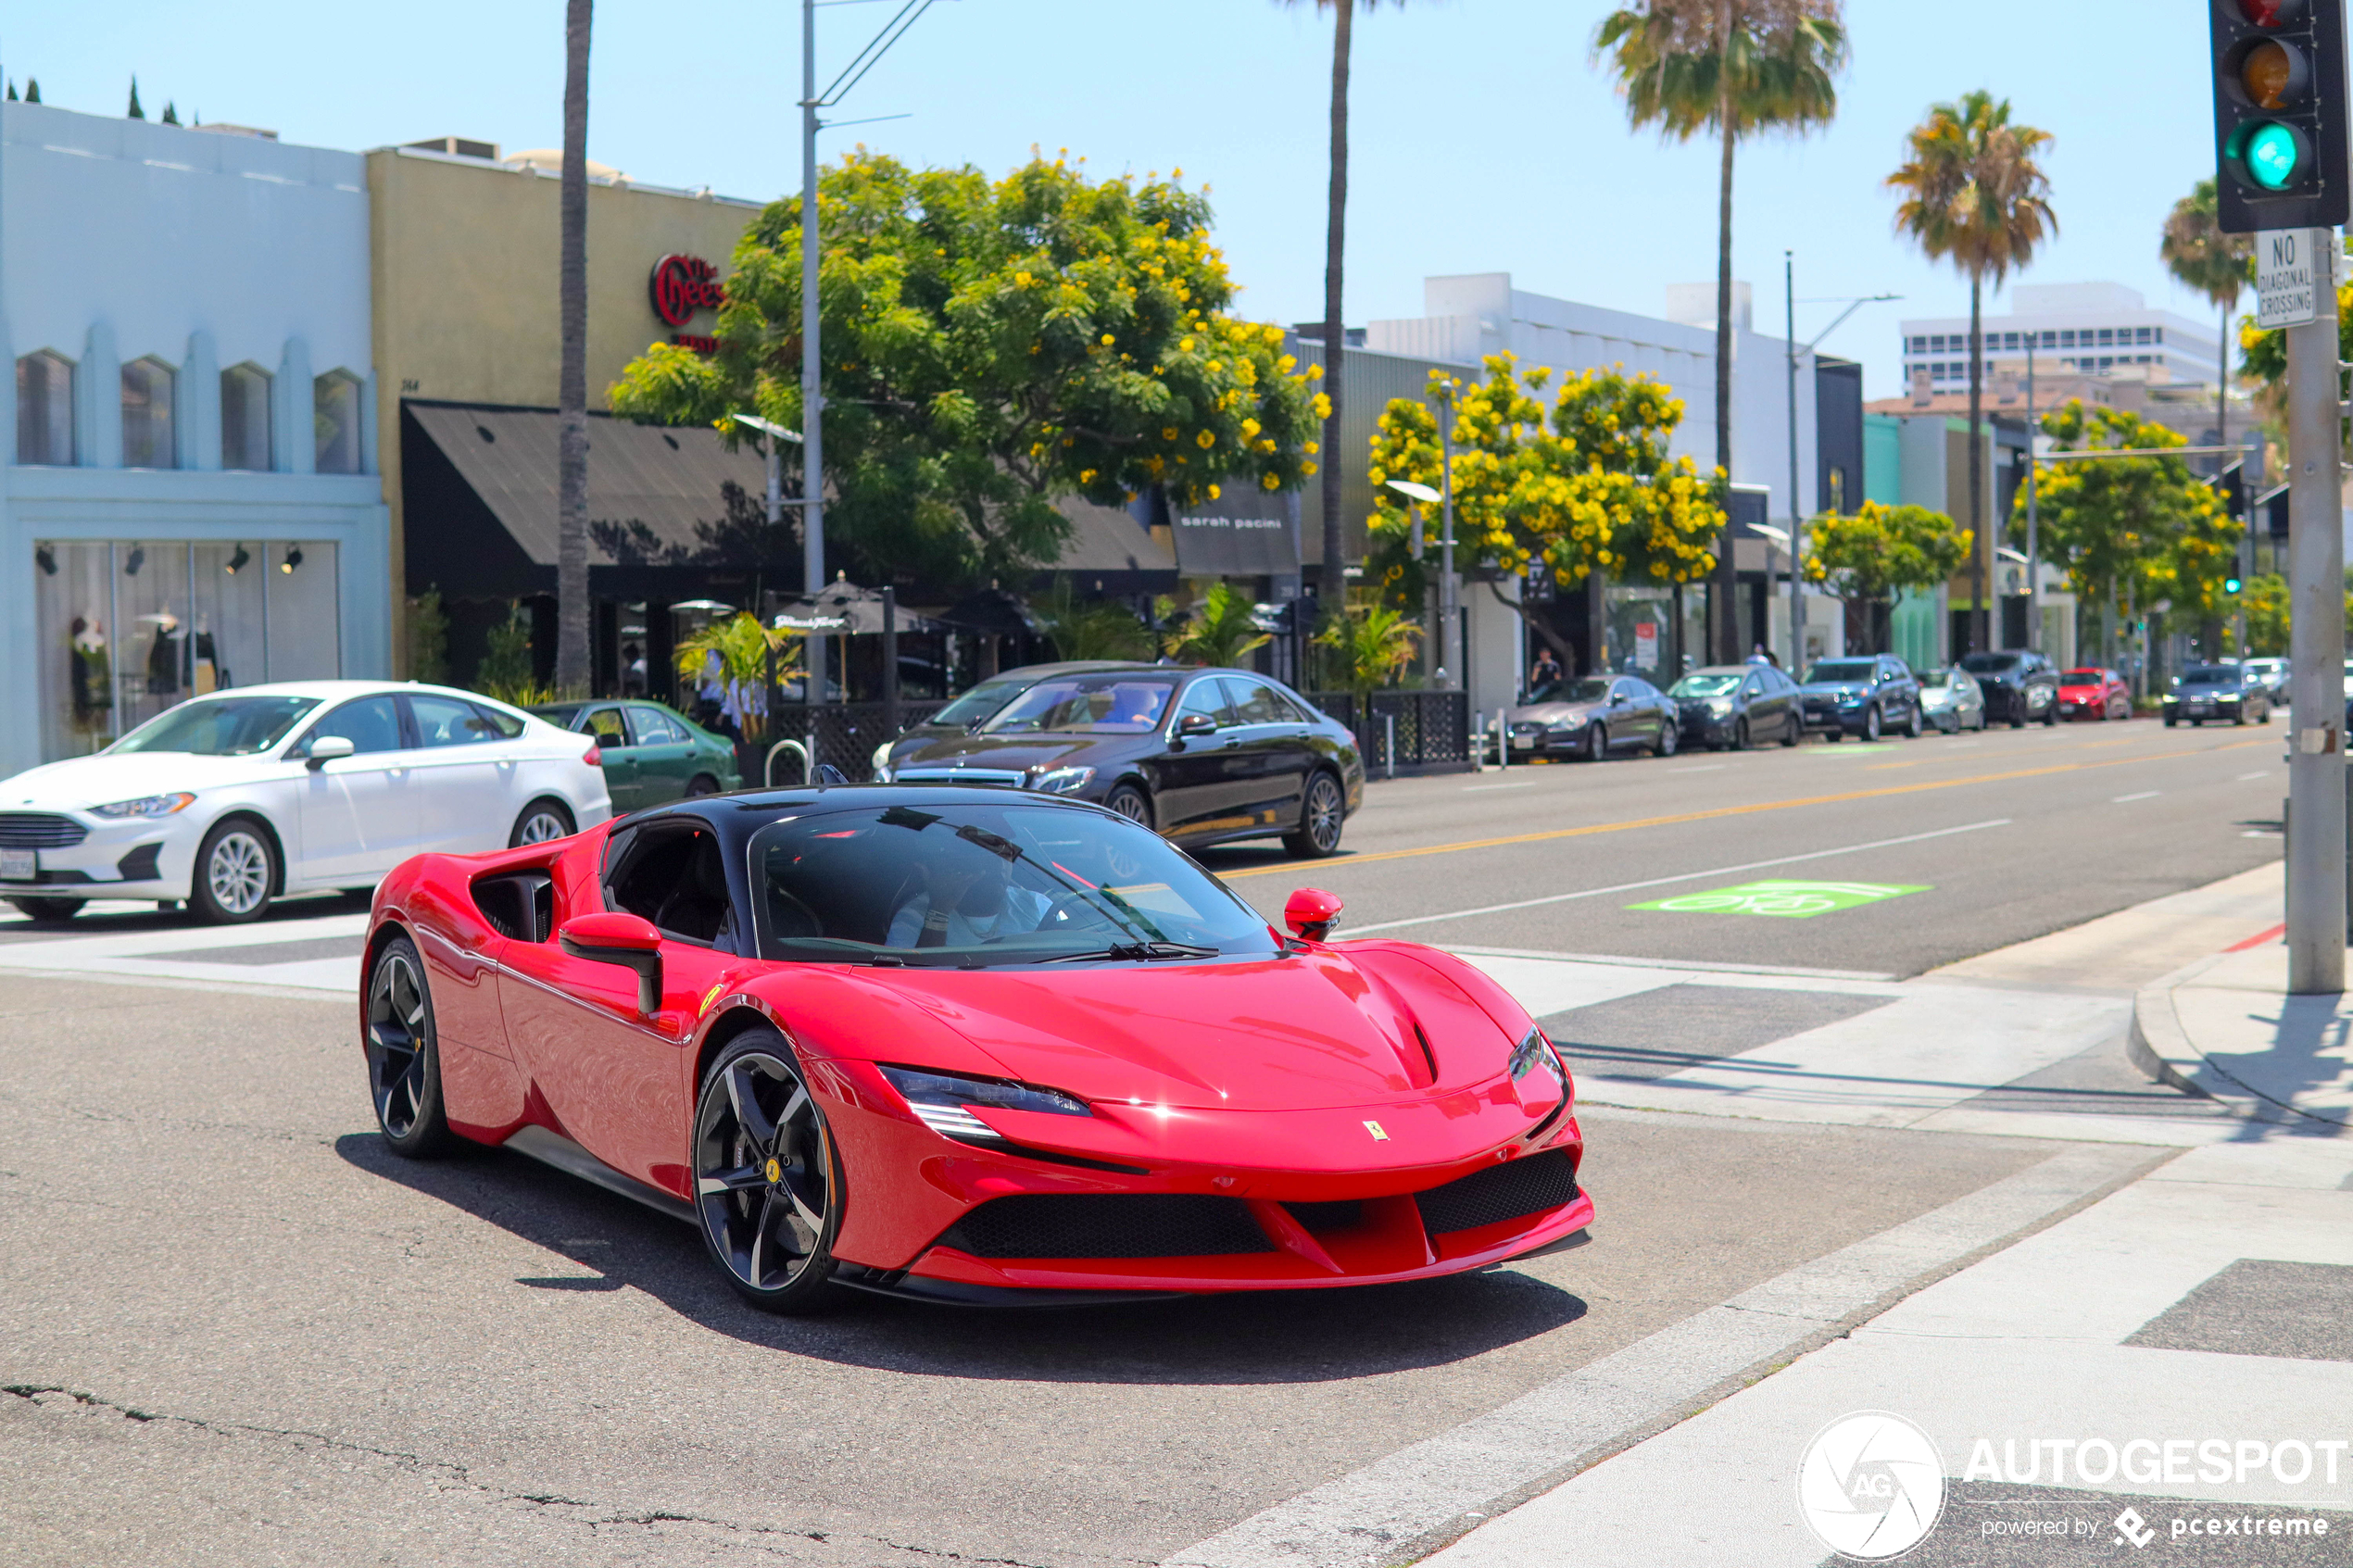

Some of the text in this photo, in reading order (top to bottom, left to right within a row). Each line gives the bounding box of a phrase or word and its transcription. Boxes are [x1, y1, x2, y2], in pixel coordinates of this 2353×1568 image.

[2272, 234, 2296, 268] NO
[2260, 268, 2311, 293] DIAGONAL
[2260, 291, 2311, 317] CROSSING
[1181, 516, 1282, 530] sarah pacini
